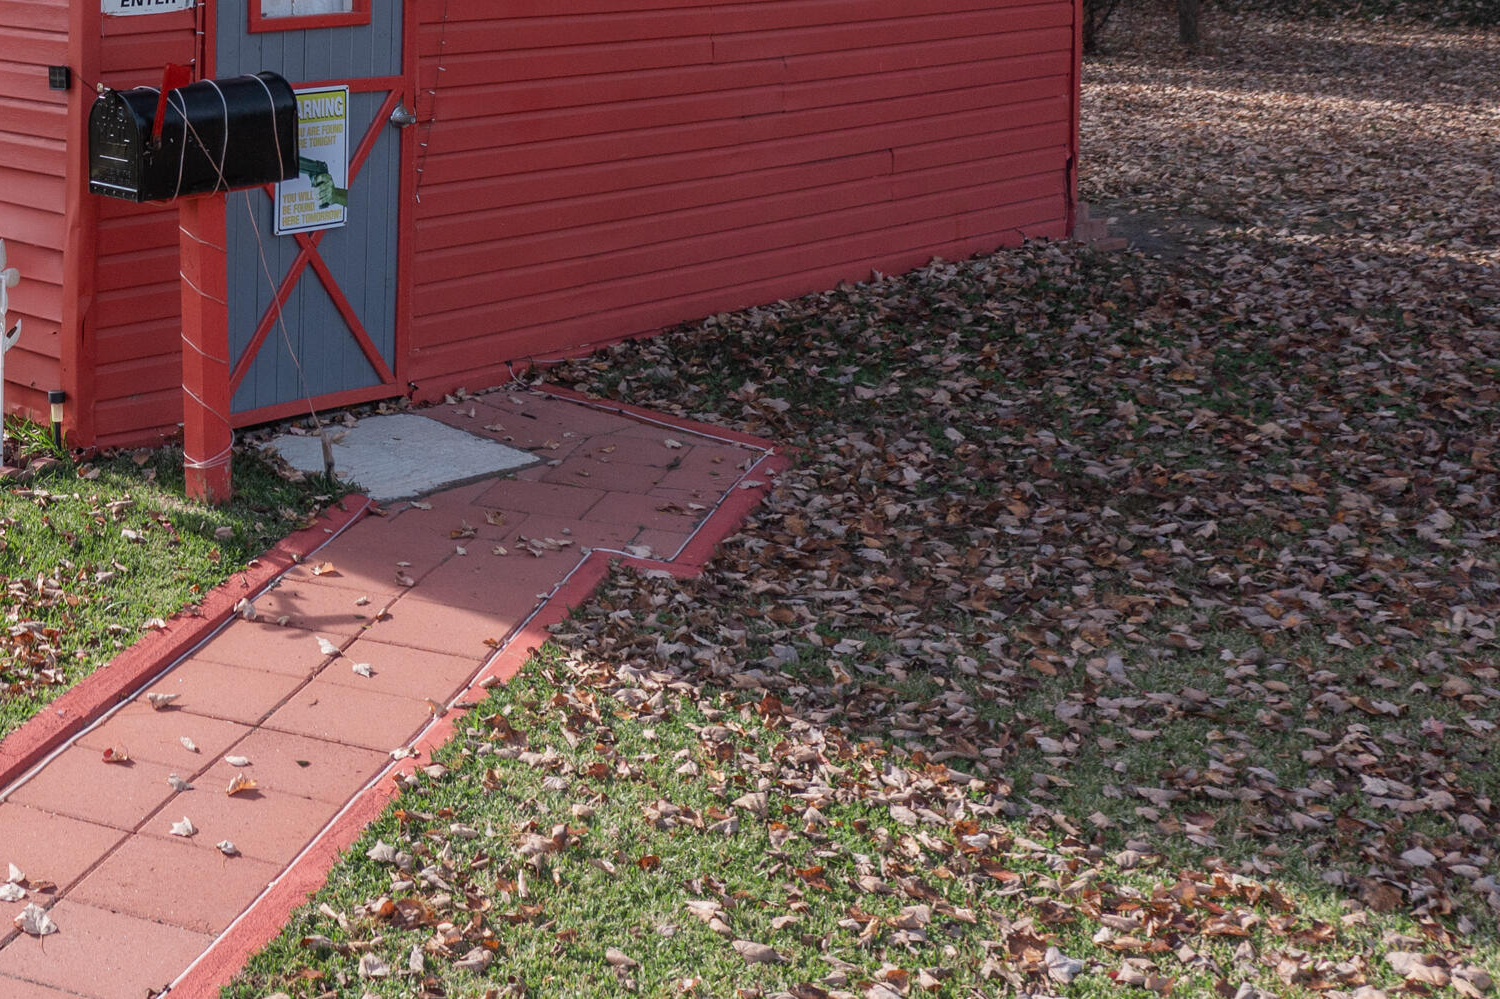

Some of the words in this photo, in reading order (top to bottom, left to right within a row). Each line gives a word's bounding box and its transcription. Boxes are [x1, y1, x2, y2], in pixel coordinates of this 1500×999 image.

[298, 96, 344, 119] ARNING
[306, 126, 320, 137] ARE
[309, 137, 337, 147] TONIGHT
[283, 193, 297, 203] YOU
[298, 191, 314, 201] WILL
[282, 206, 291, 215] BE
[293, 203, 315, 214] FOUND
[282, 216, 300, 227] HERE
